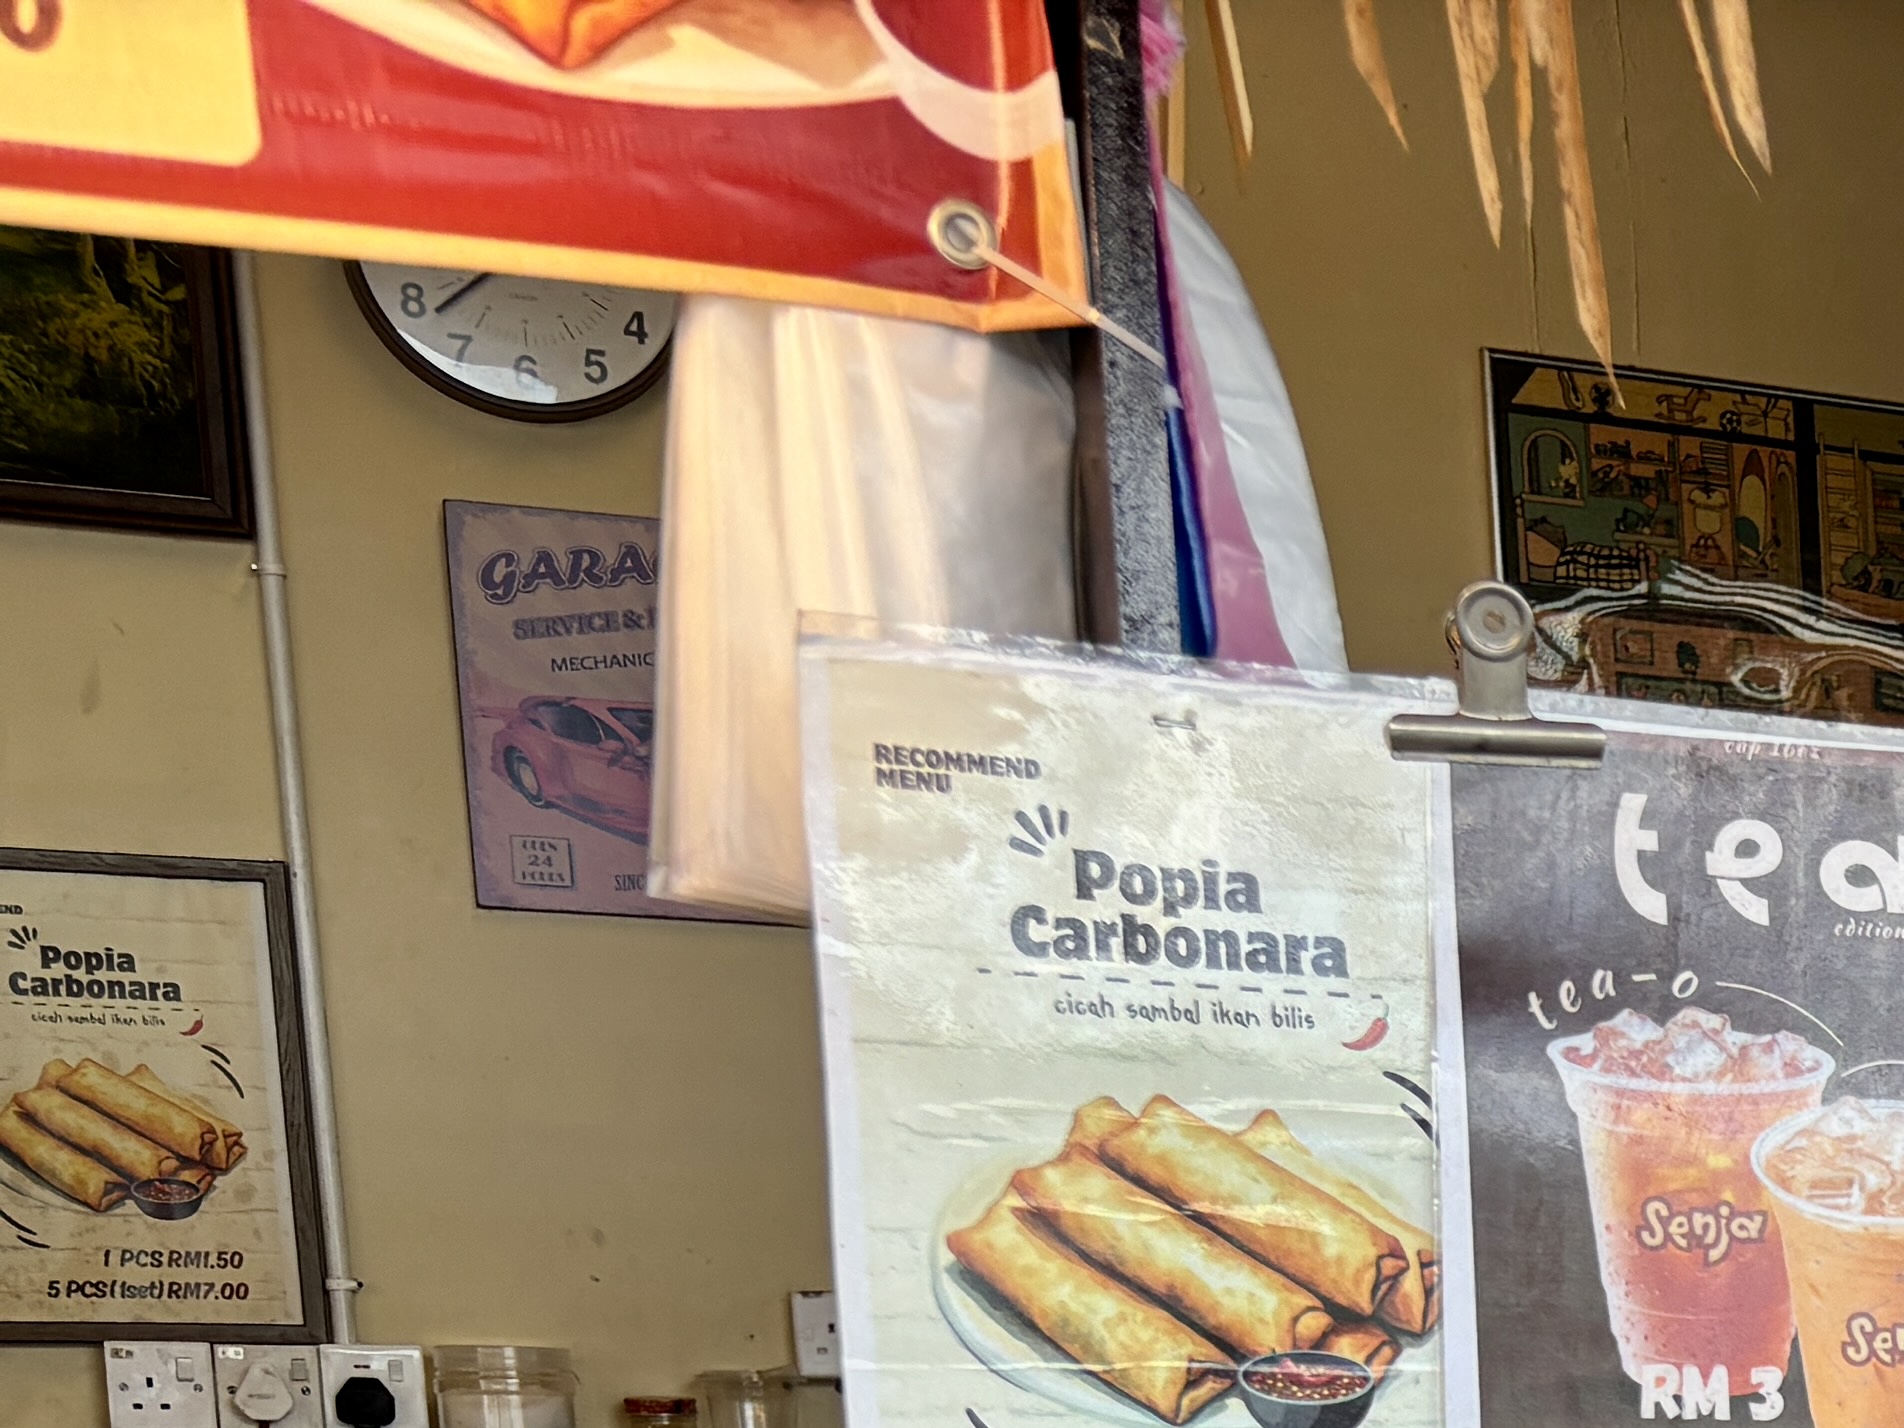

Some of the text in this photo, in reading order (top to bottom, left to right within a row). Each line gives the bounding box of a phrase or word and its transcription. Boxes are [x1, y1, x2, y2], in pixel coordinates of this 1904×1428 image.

[401, 282, 426, 318] 8
[623, 311, 648, 344] 4
[584, 348, 608, 384] 5
[479, 543, 660, 605] GARA
[513, 611, 619, 640] SERVICE
[873, 743, 1041, 780] RECOMMEND
[875, 769, 952, 795] MENU
[1071, 847, 1262, 918] Popia
[1010, 904, 1350, 979] Carbonara
[39, 944, 137, 976] Popia
[8, 971, 182, 1002] Carbonara
[1054, 995, 1316, 1030] cicah sambal ikan bilis
[1638, 1197, 1766, 1265] Senja
[120, 1250, 164, 1269] PCS
[168, 1250, 244, 1270] RM1.50
[47, 1280, 60, 1299] 5
[168, 1281, 250, 1301] RM7.00
[1639, 1363, 1786, 1422] RM 3
